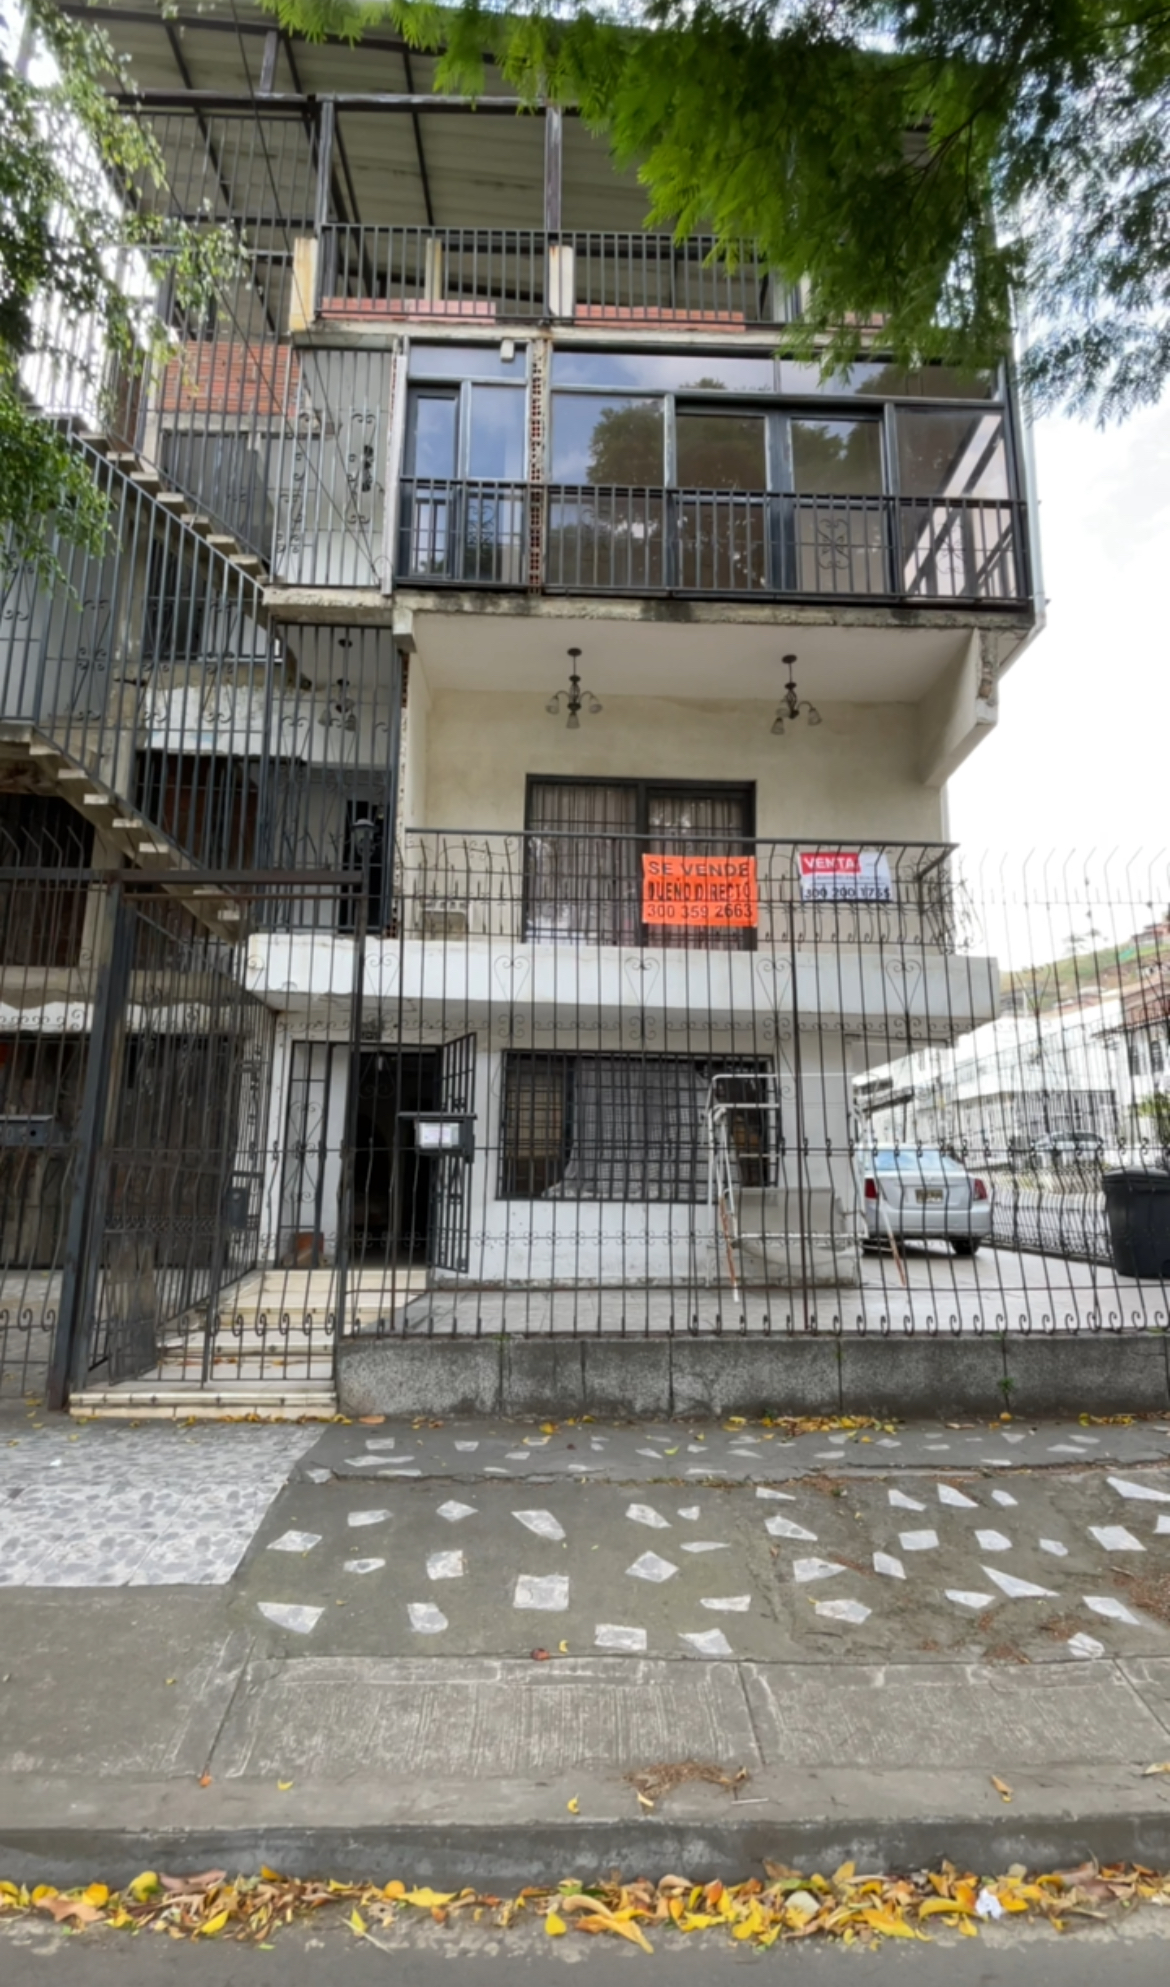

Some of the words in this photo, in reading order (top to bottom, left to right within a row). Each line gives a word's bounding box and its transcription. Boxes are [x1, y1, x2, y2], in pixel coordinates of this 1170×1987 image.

[648, 861, 673, 875] SE
[681, 862, 749, 877] VENDE
[803, 856, 856, 869] VENTA
[648, 878, 691, 902] DUEÑO
[648, 904, 675, 918] 300
[681, 905, 709, 918] 359
[715, 903, 752, 918] 2663
